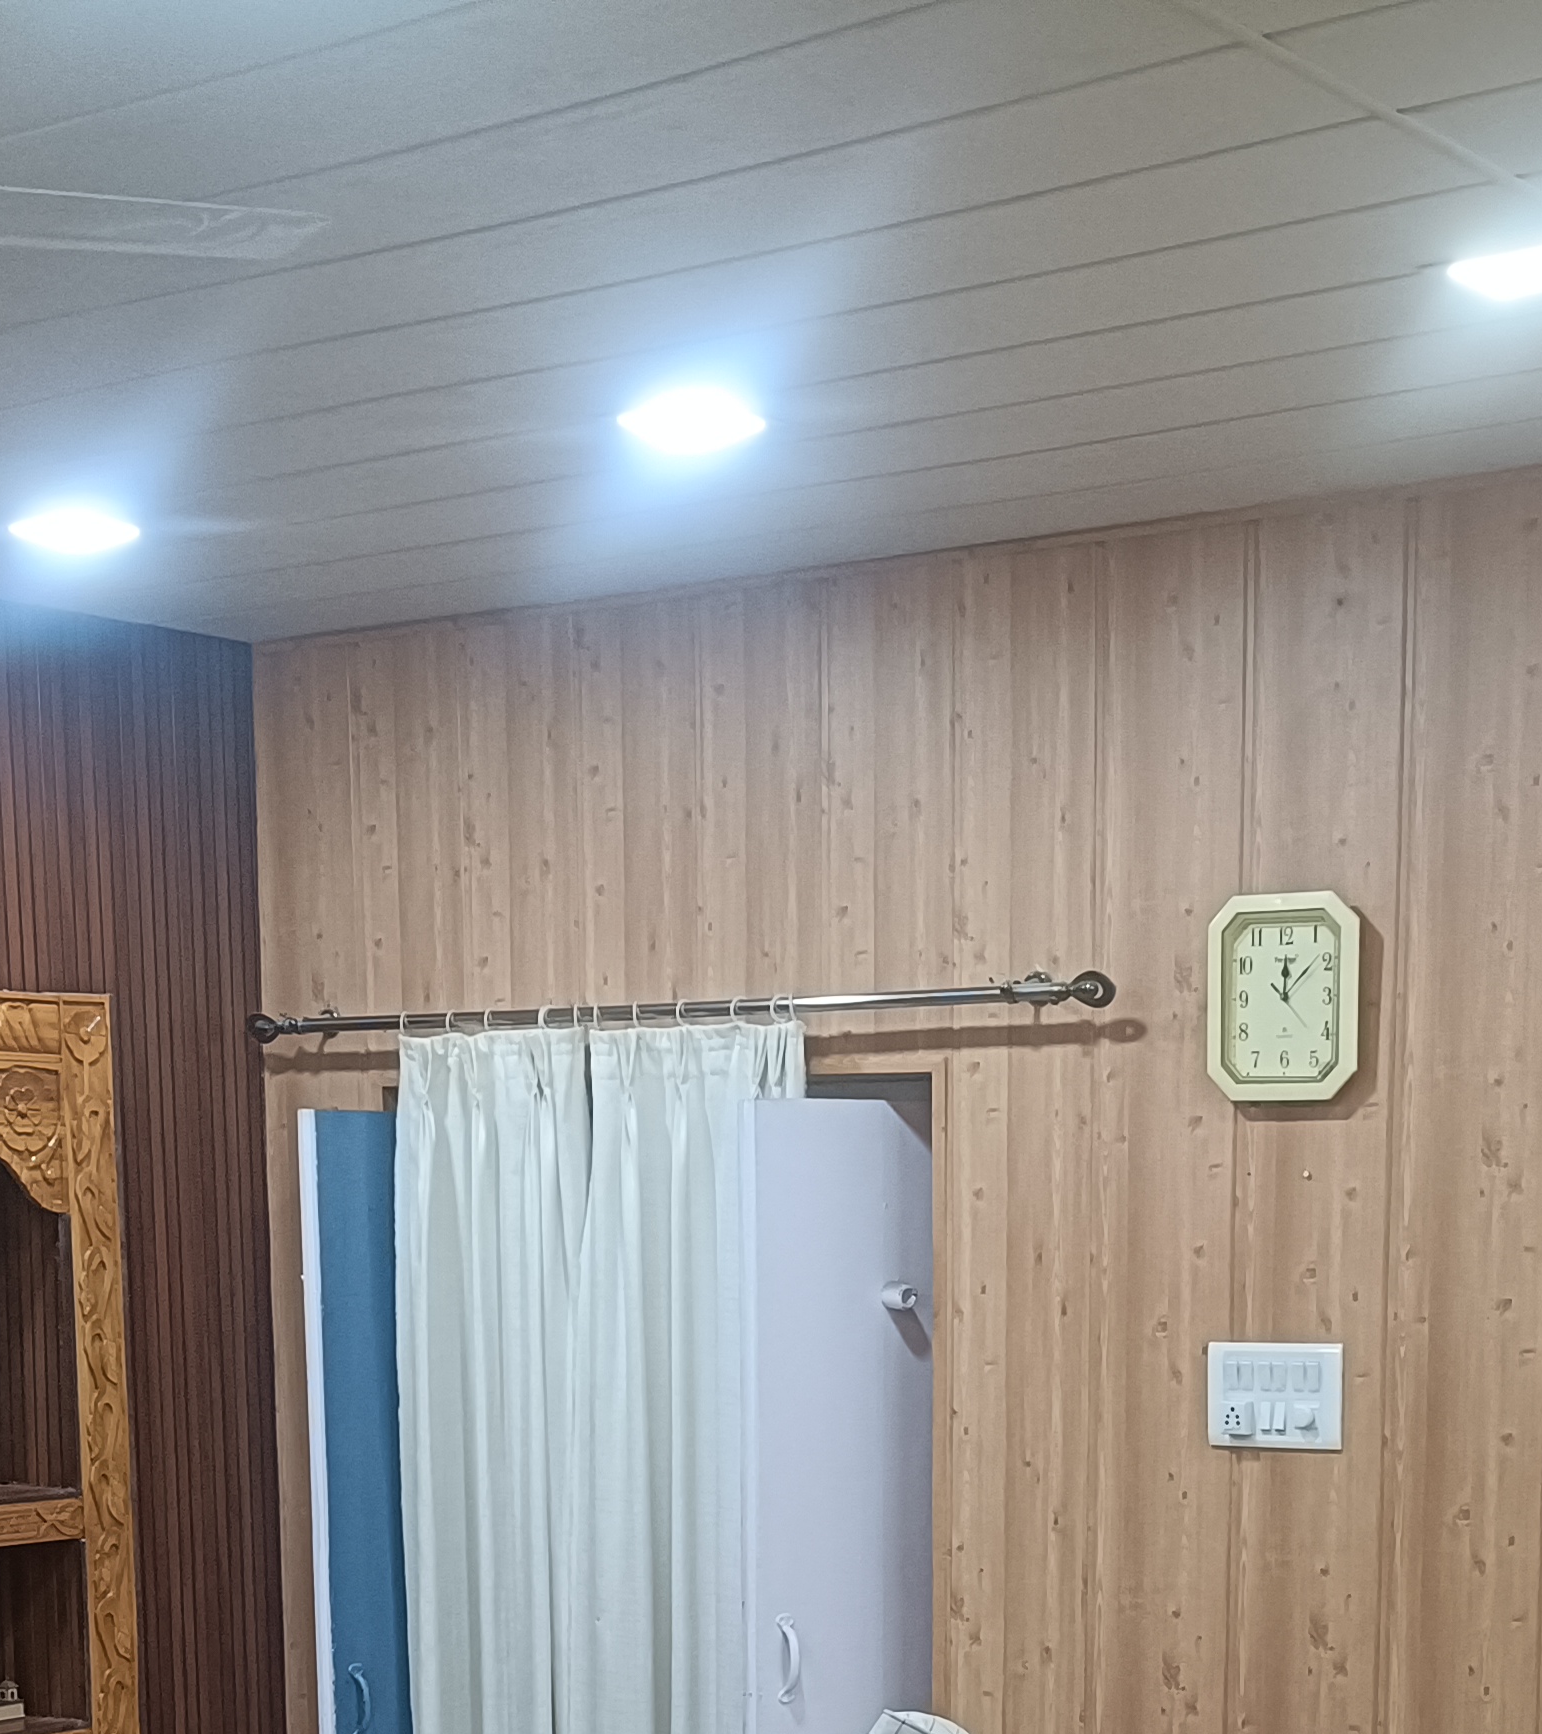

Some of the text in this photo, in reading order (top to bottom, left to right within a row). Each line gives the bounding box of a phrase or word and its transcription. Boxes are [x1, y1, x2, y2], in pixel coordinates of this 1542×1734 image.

[1251, 927, 1263, 947] 11
[1279, 926, 1294, 946] 12
[1239, 956, 1253, 975] 10
[1322, 952, 1333, 971] 2
[1239, 990, 1249, 1008] 9
[1322, 987, 1332, 1005] 3
[1239, 1022, 1249, 1041] 8
[1321, 1020, 1331, 1041] 4
[1251, 1051, 1260, 1068] 7
[1279, 1051, 1290, 1068] 6
[1309, 1050, 1320, 1068] 5
